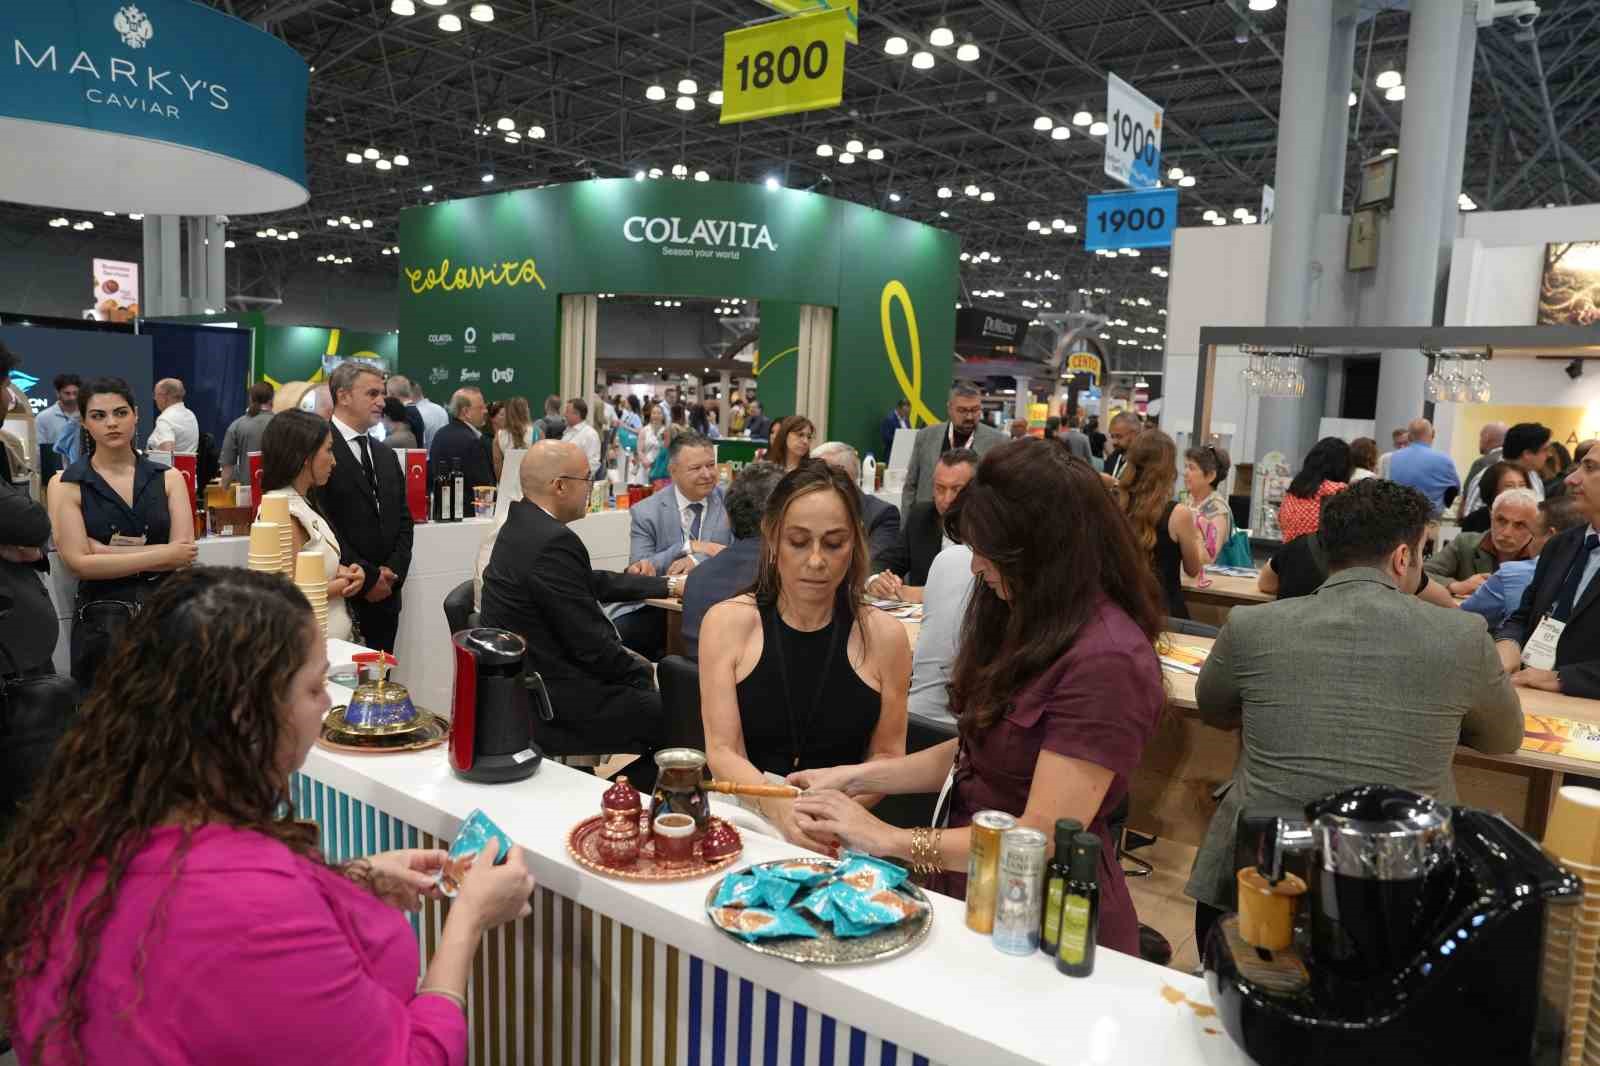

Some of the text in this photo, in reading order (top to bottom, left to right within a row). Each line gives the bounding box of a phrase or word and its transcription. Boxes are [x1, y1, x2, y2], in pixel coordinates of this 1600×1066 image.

[15, 39, 230, 110] MARKY'S
[736, 40, 828, 92] 1800
[86, 89, 180, 119] CAVIAR
[1113, 108, 1155, 167] 1900
[623, 216, 777, 251] COLAVITA
[1097, 207, 1165, 232] 1900
[662, 246, 740, 260] Season your world
[405, 259, 546, 293] colavita
